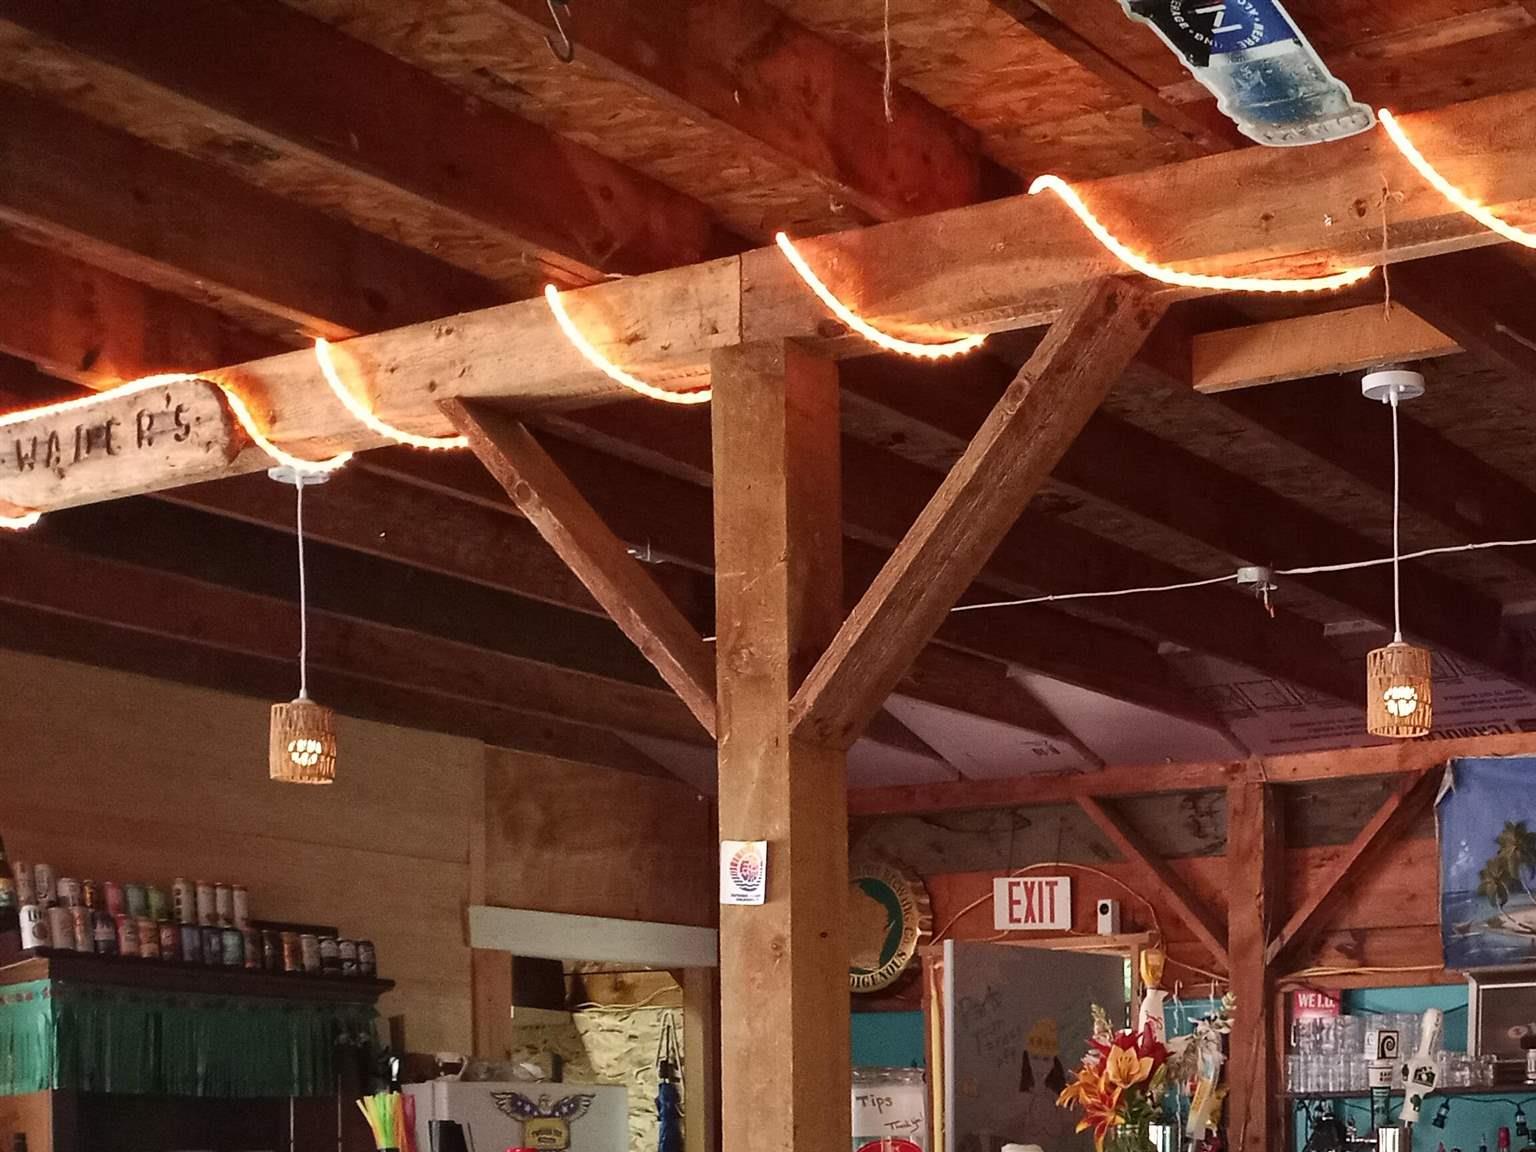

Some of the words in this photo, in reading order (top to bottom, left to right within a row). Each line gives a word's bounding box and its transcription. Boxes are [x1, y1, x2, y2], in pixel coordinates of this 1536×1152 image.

[1008, 881, 1058, 924] EXIT
[1298, 993, 1316, 1008] WE
[855, 1094, 894, 1115] Tips
